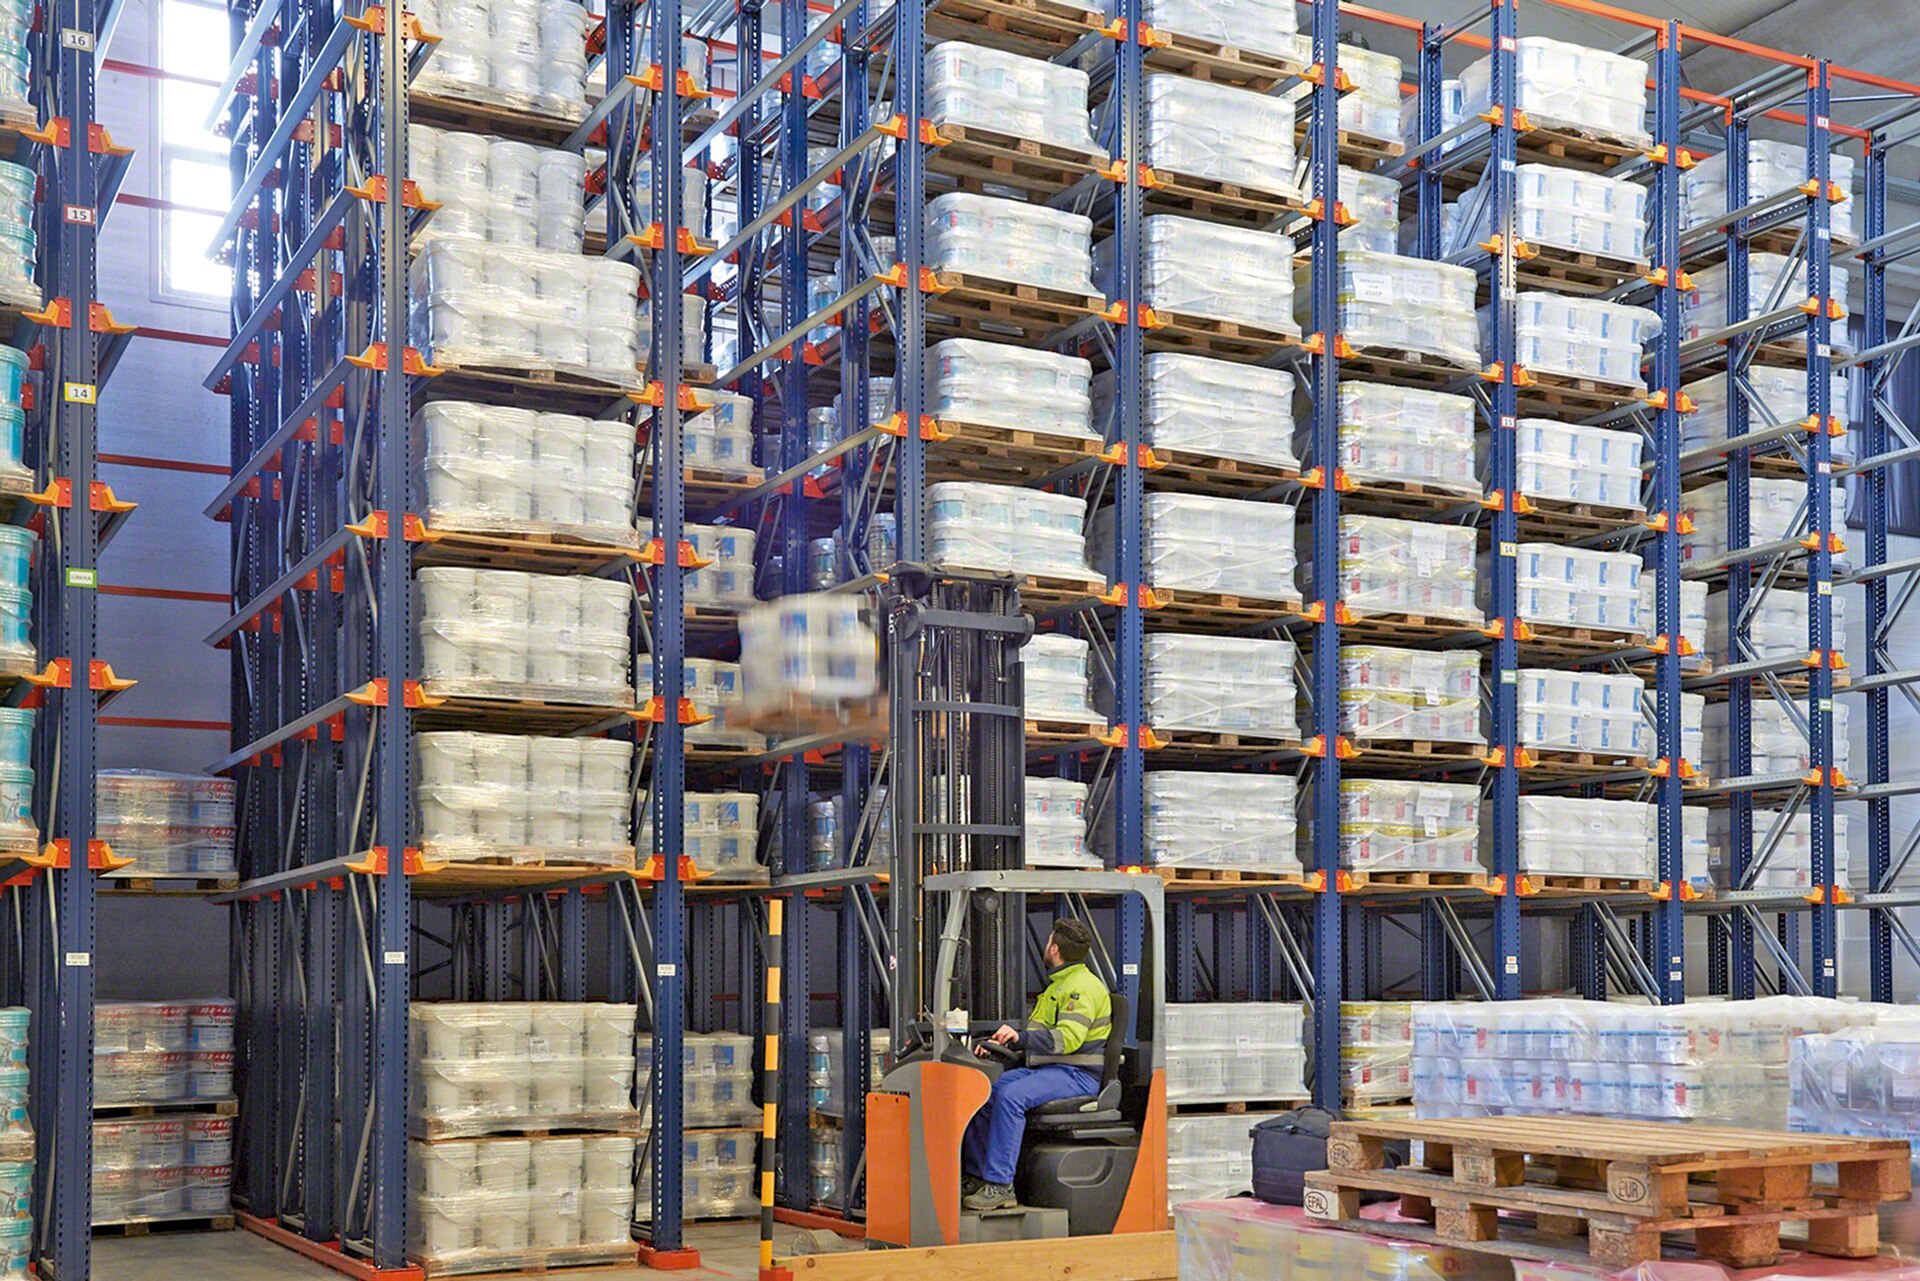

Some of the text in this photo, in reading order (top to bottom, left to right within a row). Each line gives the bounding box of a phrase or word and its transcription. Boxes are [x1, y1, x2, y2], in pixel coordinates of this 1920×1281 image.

[71, 34, 86, 46] 16
[72, 210, 87, 221] 15
[73, 388, 88, 398] 14
[1619, 1181, 1638, 1198] EUR
[1308, 1195, 1324, 1210] EPAL
